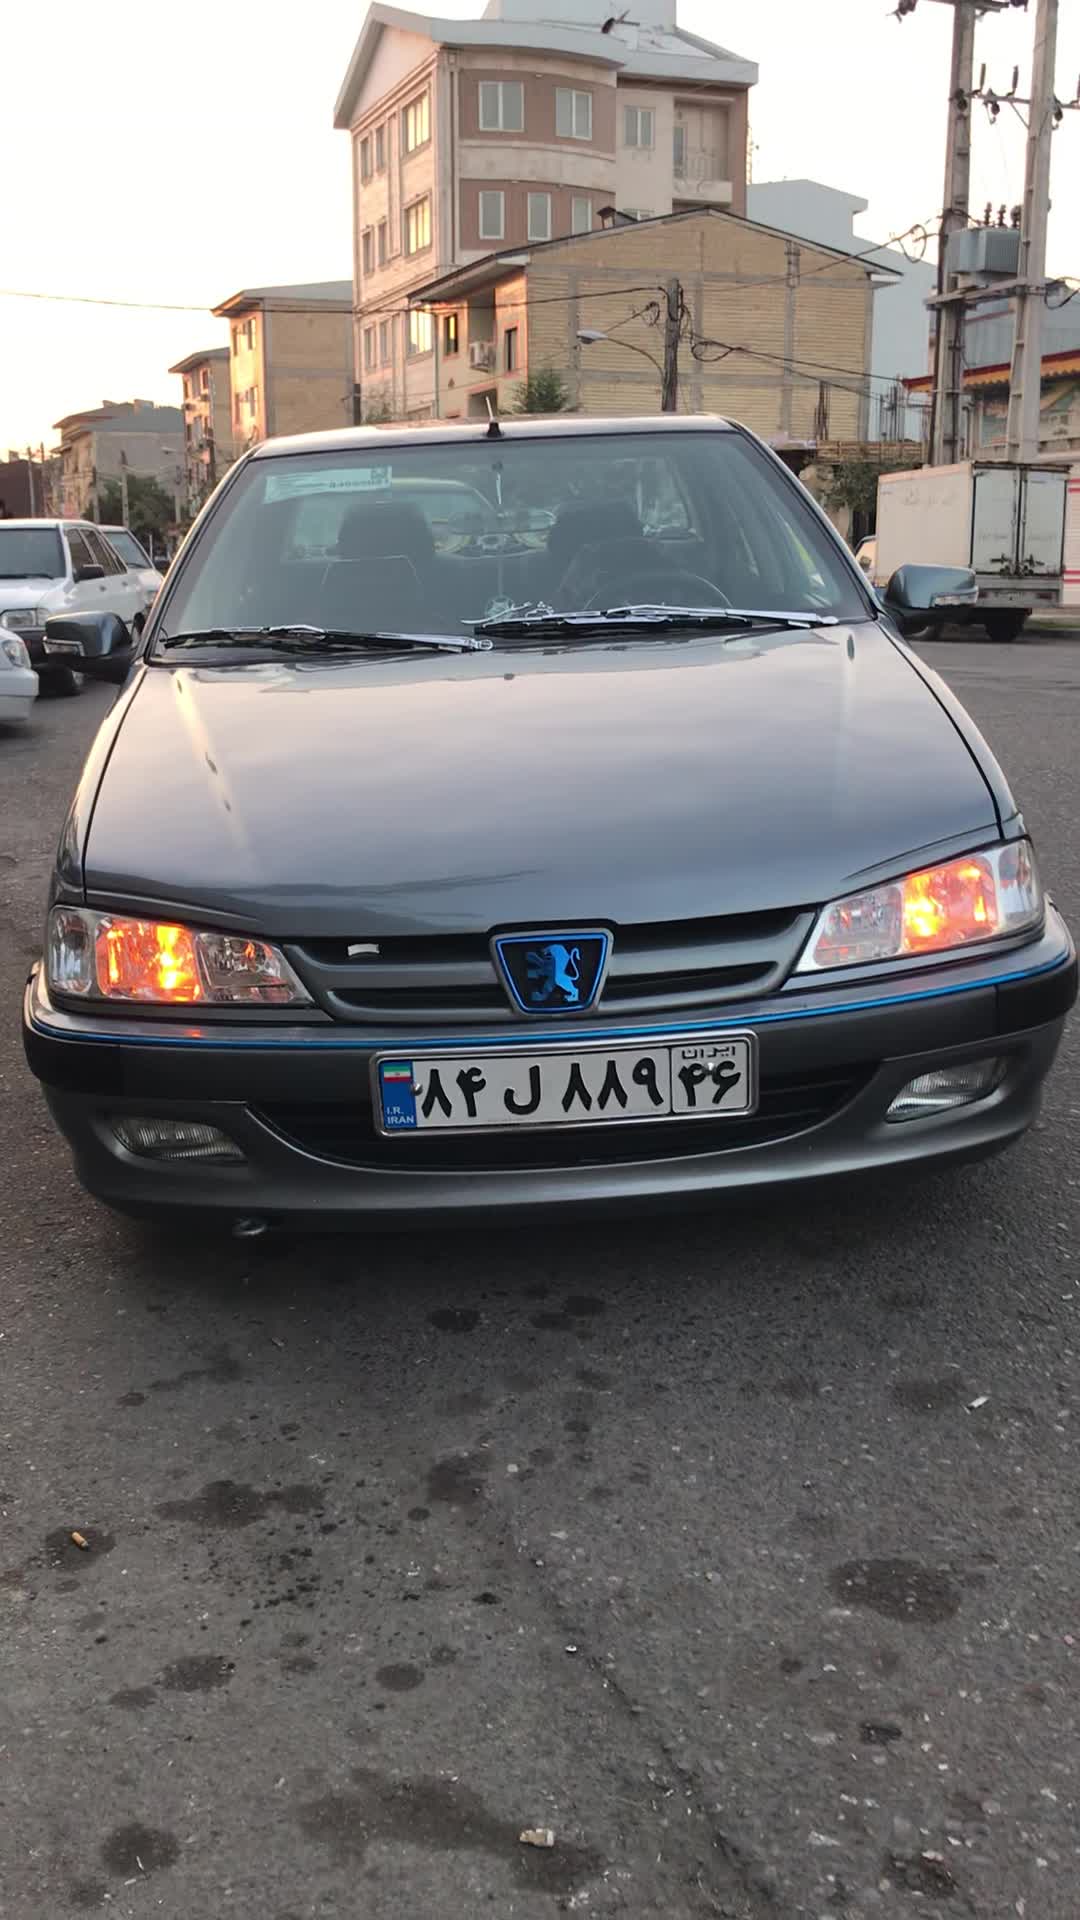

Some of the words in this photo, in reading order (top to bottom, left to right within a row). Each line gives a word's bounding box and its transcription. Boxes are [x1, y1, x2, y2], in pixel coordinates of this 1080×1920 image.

[682, 1046, 736, 1059] ایران
[503, 1065, 541, 1115] ل
[386, 1106, 404, 1115] I.R.
[387, 1115, 414, 1125] IRAN
